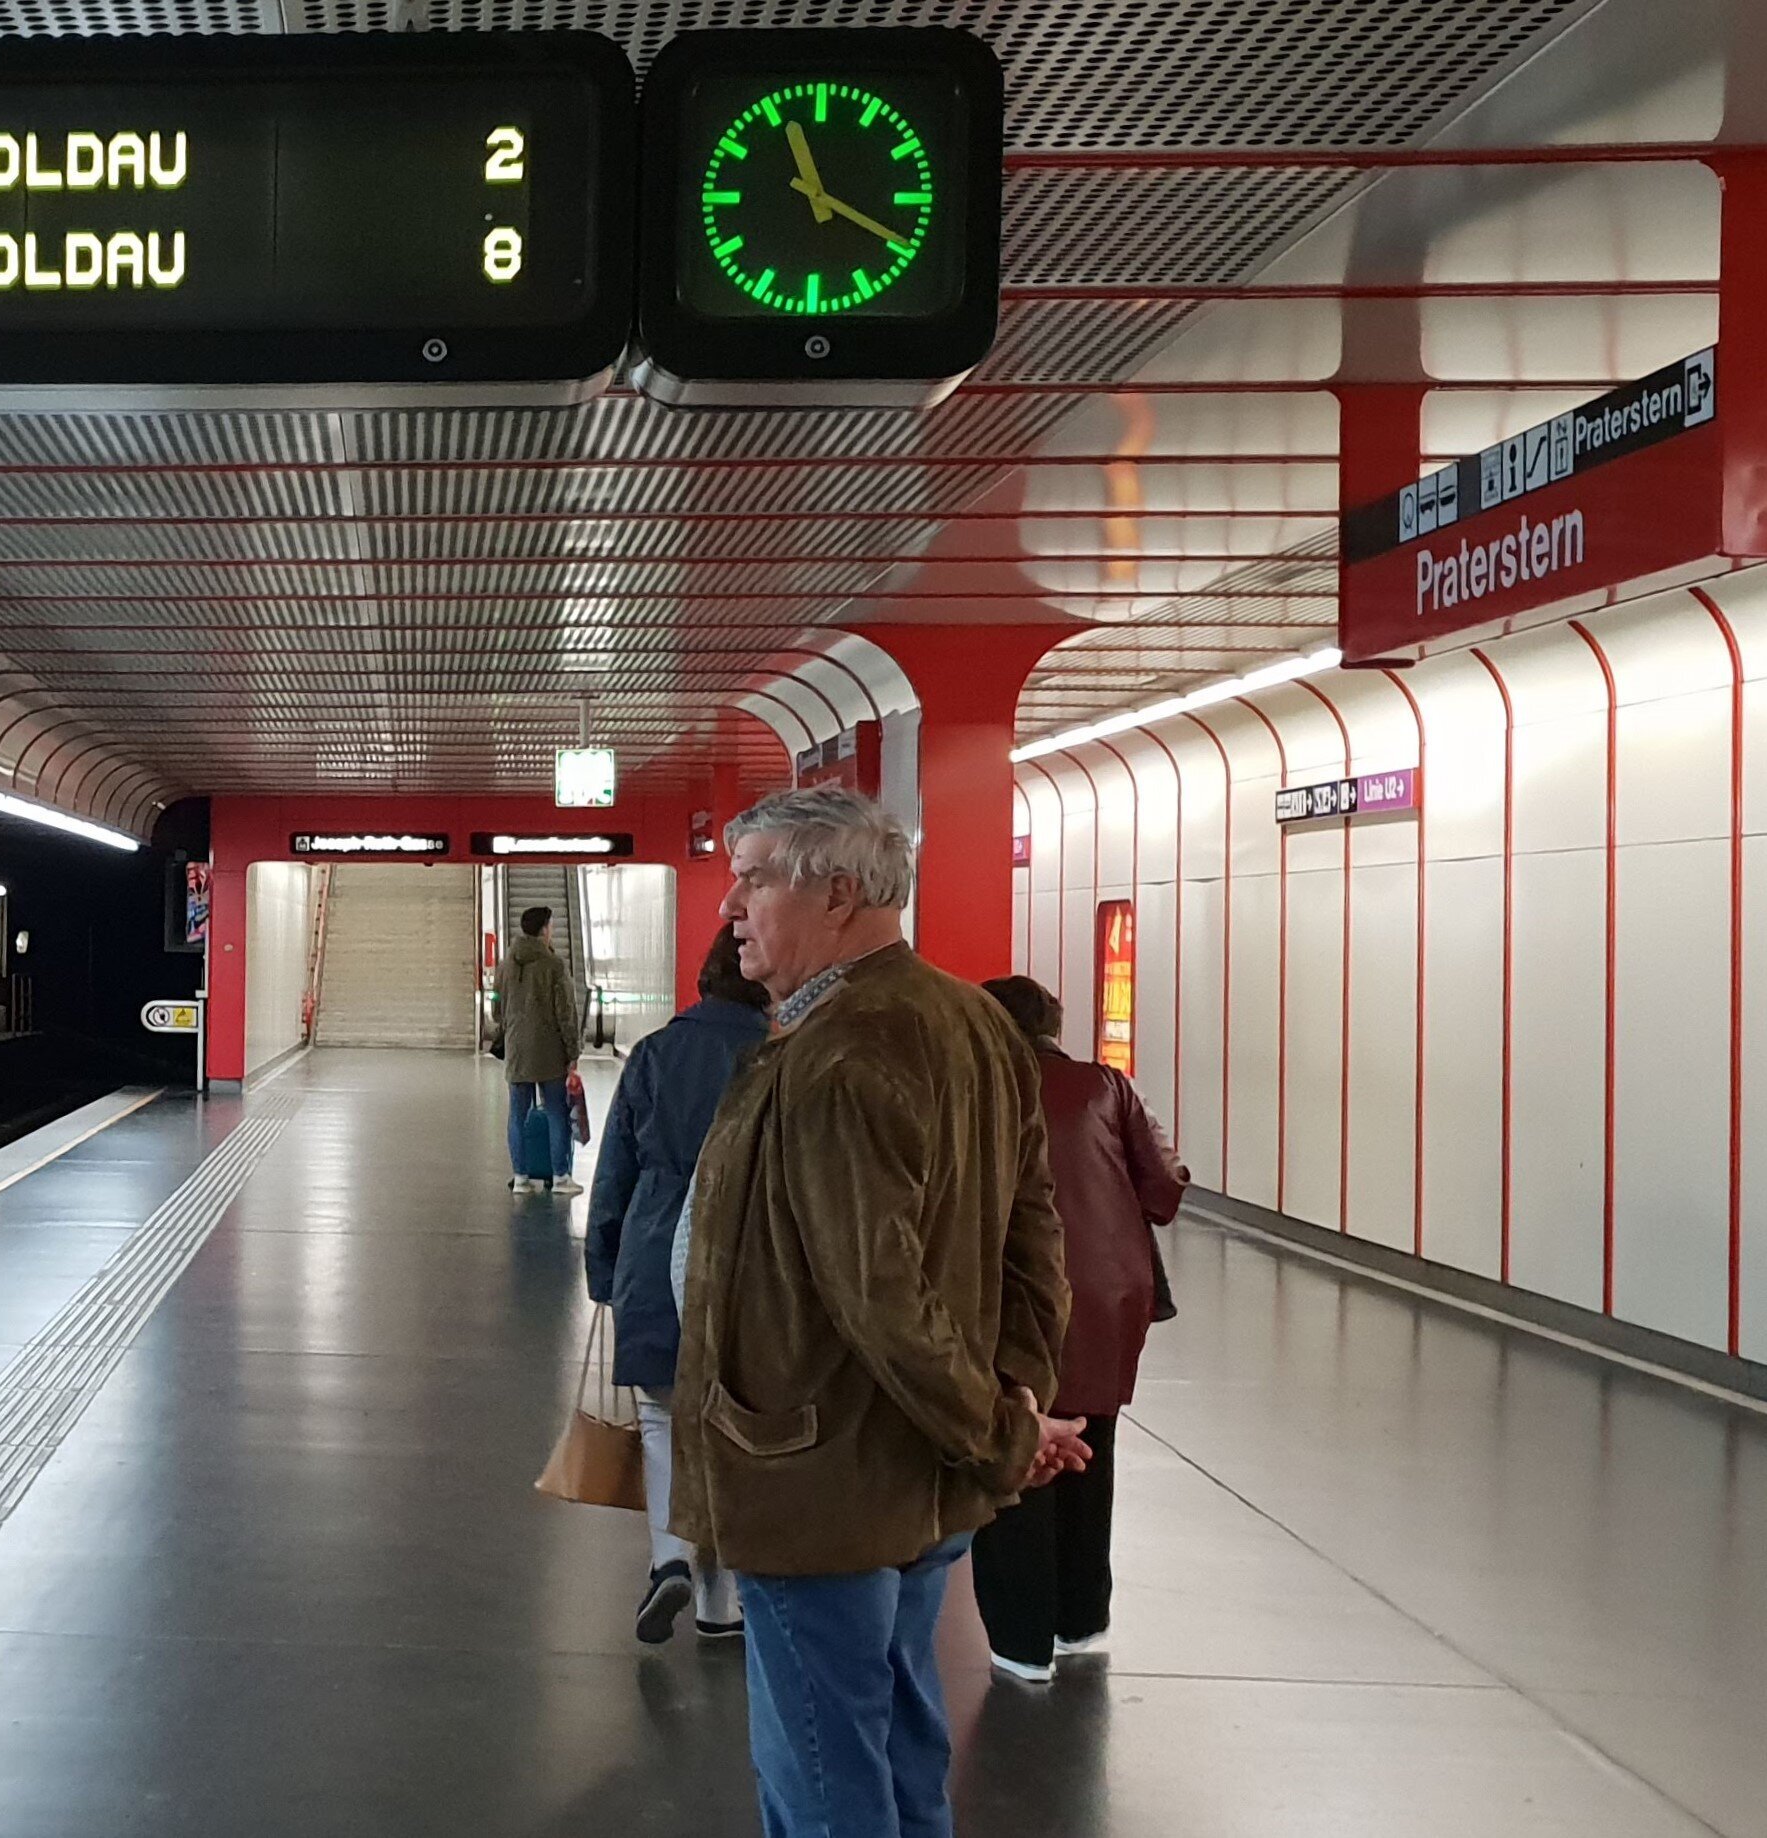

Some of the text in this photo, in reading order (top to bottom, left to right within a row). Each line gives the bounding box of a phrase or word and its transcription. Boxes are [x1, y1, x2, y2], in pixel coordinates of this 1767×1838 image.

[484, 126, 524, 183] 2
[483, 226, 523, 284] 8
[1575, 383, 1682, 455] Praterstern
[1416, 508, 1584, 615] Praterstern
